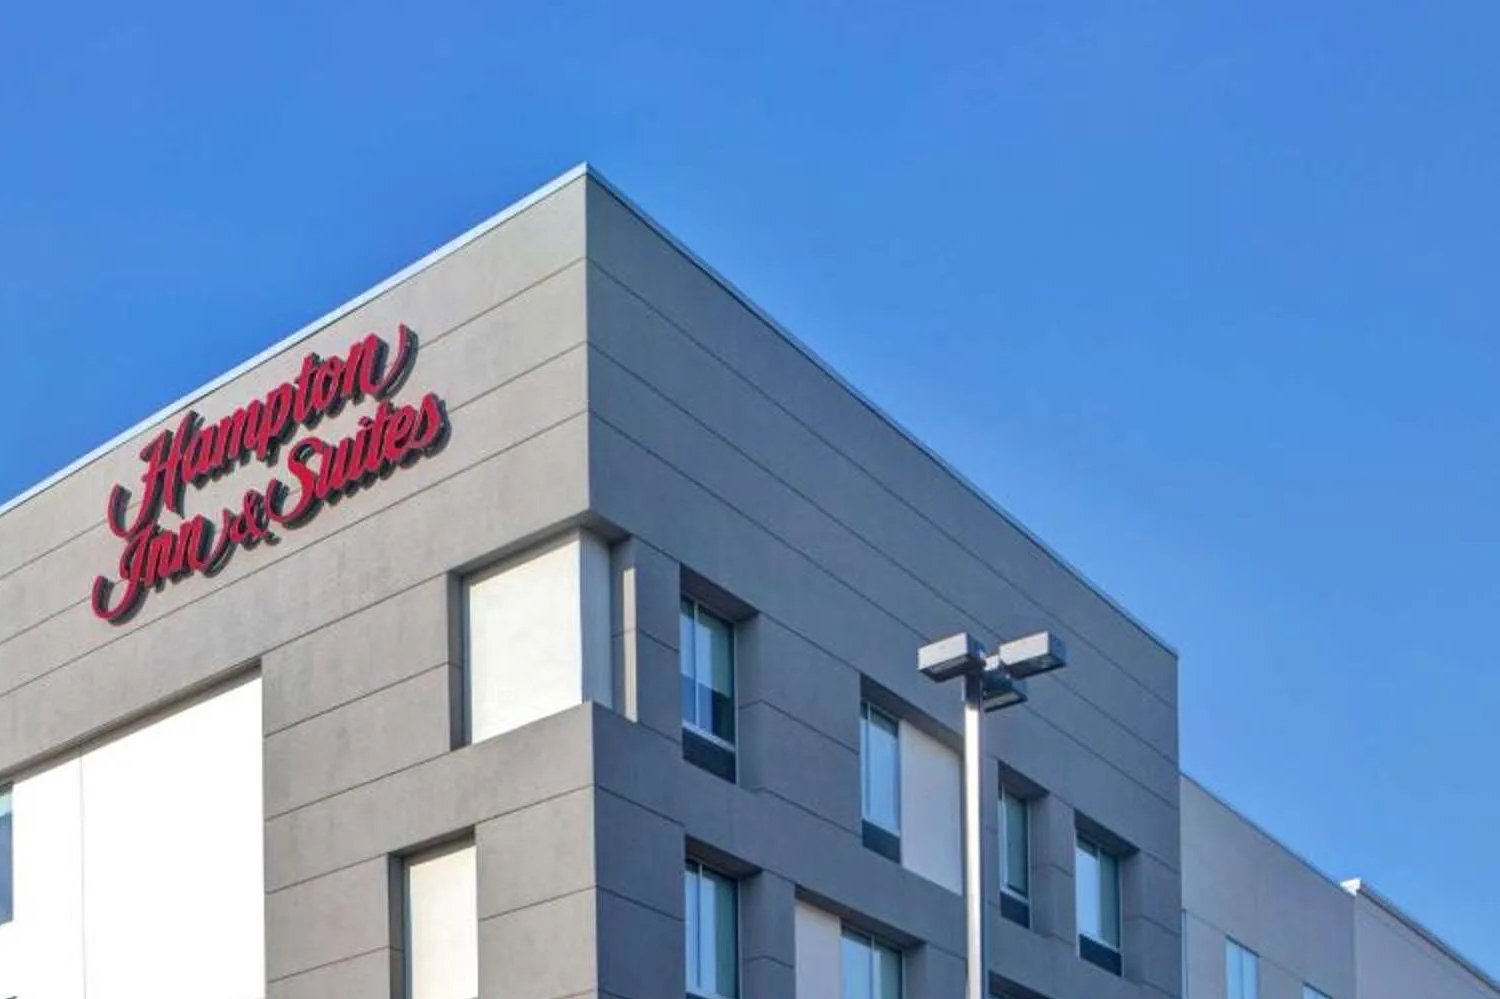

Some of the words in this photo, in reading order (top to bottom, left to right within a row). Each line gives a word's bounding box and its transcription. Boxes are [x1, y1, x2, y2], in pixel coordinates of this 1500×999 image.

[91, 508, 233, 624] Inn
[229, 489, 280, 545] &
[266, 393, 451, 529] Suites
[108, 323, 417, 538] Hampton
